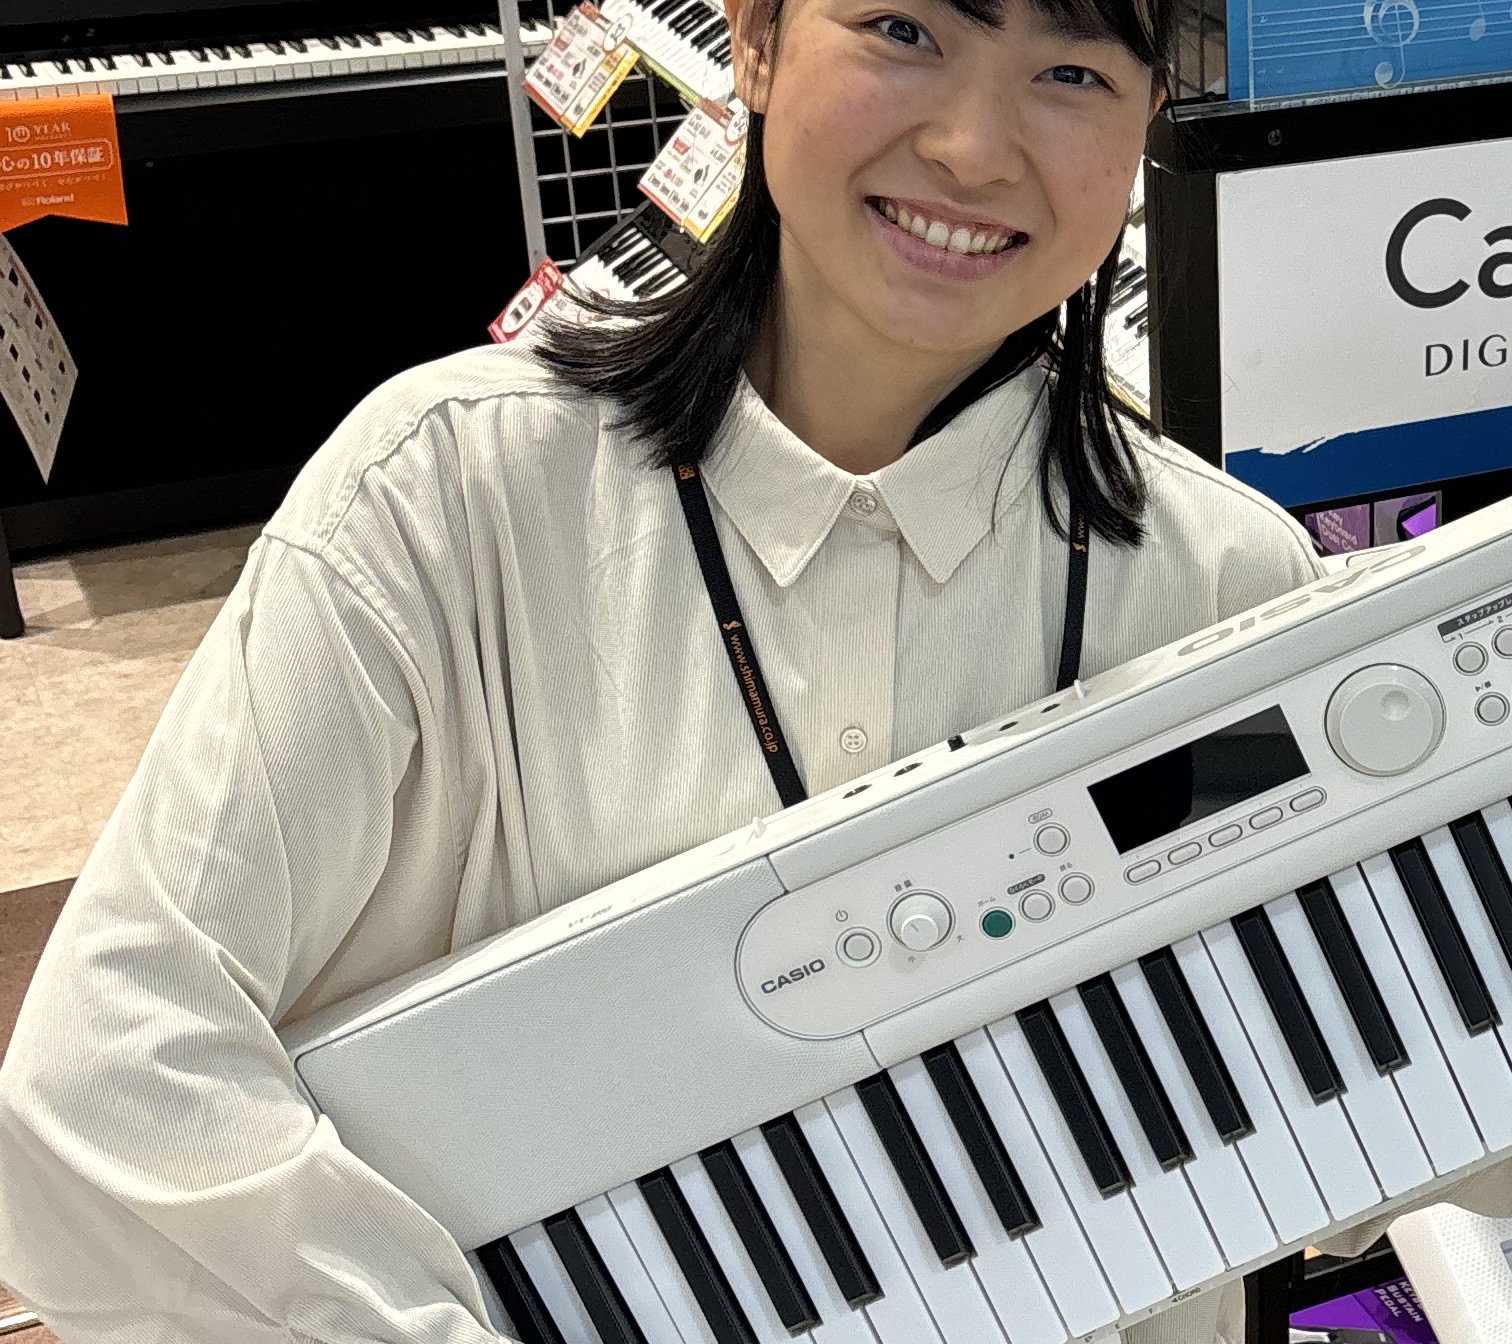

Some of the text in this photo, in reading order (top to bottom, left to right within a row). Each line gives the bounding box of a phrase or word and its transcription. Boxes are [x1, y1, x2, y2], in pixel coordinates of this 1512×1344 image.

[1177, 544, 1428, 658] CASIO
[729, 633, 779, 754] www.shimamura.co.jp
[760, 958, 826, 995] CASIO
[1374, 1287, 1401, 1318] PEDAL
[1386, 1284, 1425, 1324] SUSTAIN
